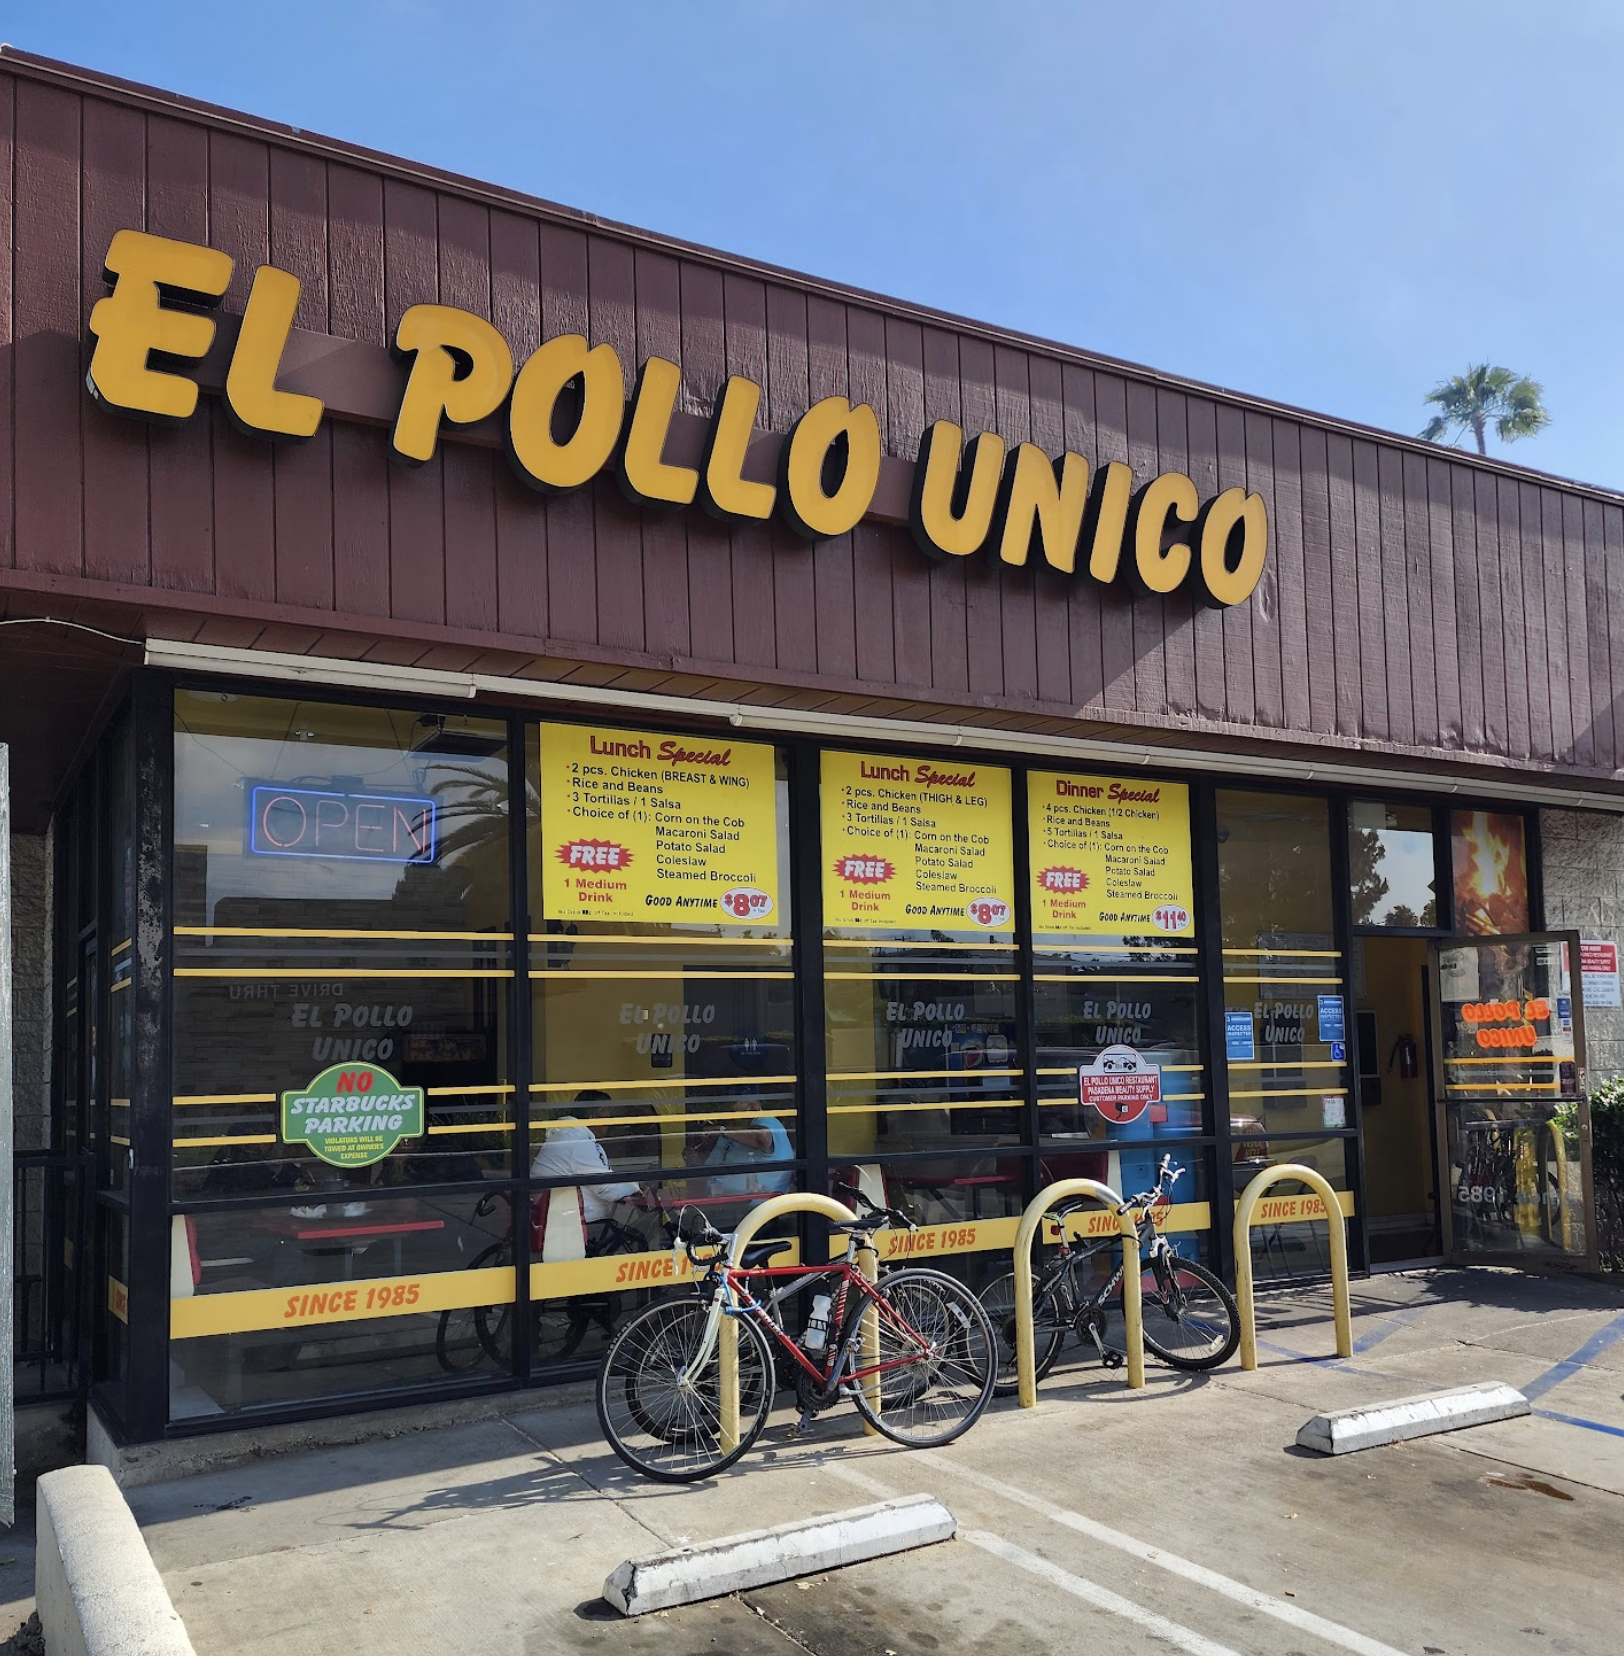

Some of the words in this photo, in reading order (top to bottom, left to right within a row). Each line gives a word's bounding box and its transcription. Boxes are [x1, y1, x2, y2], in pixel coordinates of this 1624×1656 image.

[86, 229, 324, 439] EL
[391, 304, 881, 536] POLLO
[915, 419, 1268, 608] UNICO
[590, 735, 650, 759] Lunch
[657, 741, 731, 767] Special
[572, 763, 579, 773] 2
[583, 765, 607, 776] pcs.
[611, 766, 657, 779] Chicken
[661, 770, 706, 784] (BREAST
[709, 773, 716, 784] &
[719, 775, 750, 789] WING)
[861, 761, 910, 782] Lunch
[915, 765, 976, 788] Special
[573, 777, 598, 789] Rice
[603, 780, 623, 791] and
[628, 782, 663, 794] Beans
[1056, 780, 1103, 798] Dinner
[1107, 783, 1160, 804] Special
[573, 792, 579, 801] 3
[583, 793, 630, 806] Tortillas
[651, 798, 681, 809] Salsa
[846, 786, 852, 795] 2
[855, 788, 875, 798] pcs.
[878, 790, 916, 800] Chicken
[919, 792, 951, 803] (THIGH
[965, 796, 987, 807] LEG)
[847, 800, 867, 810] Rice
[871, 803, 888, 811] and
[892, 803, 921, 814] Beans
[1054, 805, 1071, 814] pcs.
[1073, 805, 1106, 816] Chicken
[1125, 809, 1159, 820] Chicken)
[263, 796, 428, 852] OPEN
[573, 807, 614, 819] Choice
[618, 810, 629, 820] of
[632, 812, 651, 823] (1):
[655, 812, 681, 824] Corn
[686, 815, 699, 825] on
[703, 815, 719, 826] the
[723, 817, 745, 827] Cob
[856, 814, 894, 825] Tortillas
[911, 818, 936, 827] Salsa
[1047, 816, 1065, 824] Rice
[1068, 817, 1082, 825] and
[1085, 818, 1110, 827] Beans
[656, 827, 706, 839] Macaroni
[710, 830, 739, 841] Salad
[847, 826, 881, 837] Choice
[884, 829, 893, 837] of
[896, 830, 911, 840] (1):
[914, 831, 937, 840] Corn
[940, 833, 951, 841] on
[954, 833, 968, 843] the
[971, 835, 989, 844] Cob
[1054, 829, 1087, 838] Tortillas
[1101, 831, 1123, 840] Salsa
[570, 845, 620, 865] FREE
[656, 841, 692, 852] Potato
[696, 843, 726, 854] Salad
[915, 843, 957, 854] Macaroni
[960, 846, 985, 856] Salad
[1047, 840, 1076, 849] Choice
[1089, 842, 1102, 851] (1):
[1105, 843, 1123, 852] Corn
[1138, 845, 1150, 854] the
[1153, 845, 1168, 854] Cob
[656, 854, 706, 866] Coleslaw
[915, 857, 945, 867] Potato
[948, 858, 973, 868] Salad
[1105, 855, 1141, 864] Macaroni
[1144, 856, 1165, 865] Salad
[656, 869, 706, 880] Steamed
[710, 871, 756, 882] Broccoli
[844, 860, 885, 878] FREE
[916, 870, 957, 880] Coleslaw
[1106, 867, 1131, 876] Potato
[1133, 867, 1155, 876] Salad
[576, 879, 627, 890] Medium
[916, 882, 956, 892] Steamed
[959, 884, 996, 893] Broccoli
[1046, 871, 1081, 888] FREE
[1106, 878, 1142, 887] Coleslaw
[578, 892, 613, 903] Drink
[850, 890, 890, 900] Medium
[1107, 889, 1142, 899] Steamed
[1145, 891, 1177, 900] Broccoli
[852, 902, 879, 911] Drink
[1051, 900, 1086, 908] Medium
[1053, 911, 1076, 919] Drink
[292, 1003, 322, 1027] EL
[333, 1003, 412, 1027] POLLO
[619, 1003, 644, 1024] EL
[653, 1003, 715, 1025] POLLO
[887, 1002, 906, 1021] EL
[913, 1001, 964, 1021] POLLO
[1083, 1001, 1100, 1018] EL
[1107, 1001, 1151, 1018] POLLO
[1254, 1002, 1270, 1018] EL
[1275, 1002, 1313, 1018] POLLO
[902, 1029, 952, 1048] UNICO
[1096, 1026, 1141, 1044] UNICO
[1265, 1026, 1305, 1042] UNICO
[312, 1037, 393, 1061] UNICO
[337, 1071, 373, 1093] NO
[291, 1095, 415, 1114] STARBUCKS
[305, 1115, 402, 1134] PARKING
[325, 1136, 358, 1144] VIOLATORS
[1261, 1202, 1296, 1218] SINCE
[1301, 1199, 1326, 1215] 1985
[1088, 1216, 1120, 1233] SINC
[888, 1233, 935, 1254] SINCE
[941, 1228, 976, 1248] 1985
[616, 1259, 673, 1282] SINCE
[284, 1289, 357, 1318] SINCE
[365, 1284, 420, 1310] 1985
